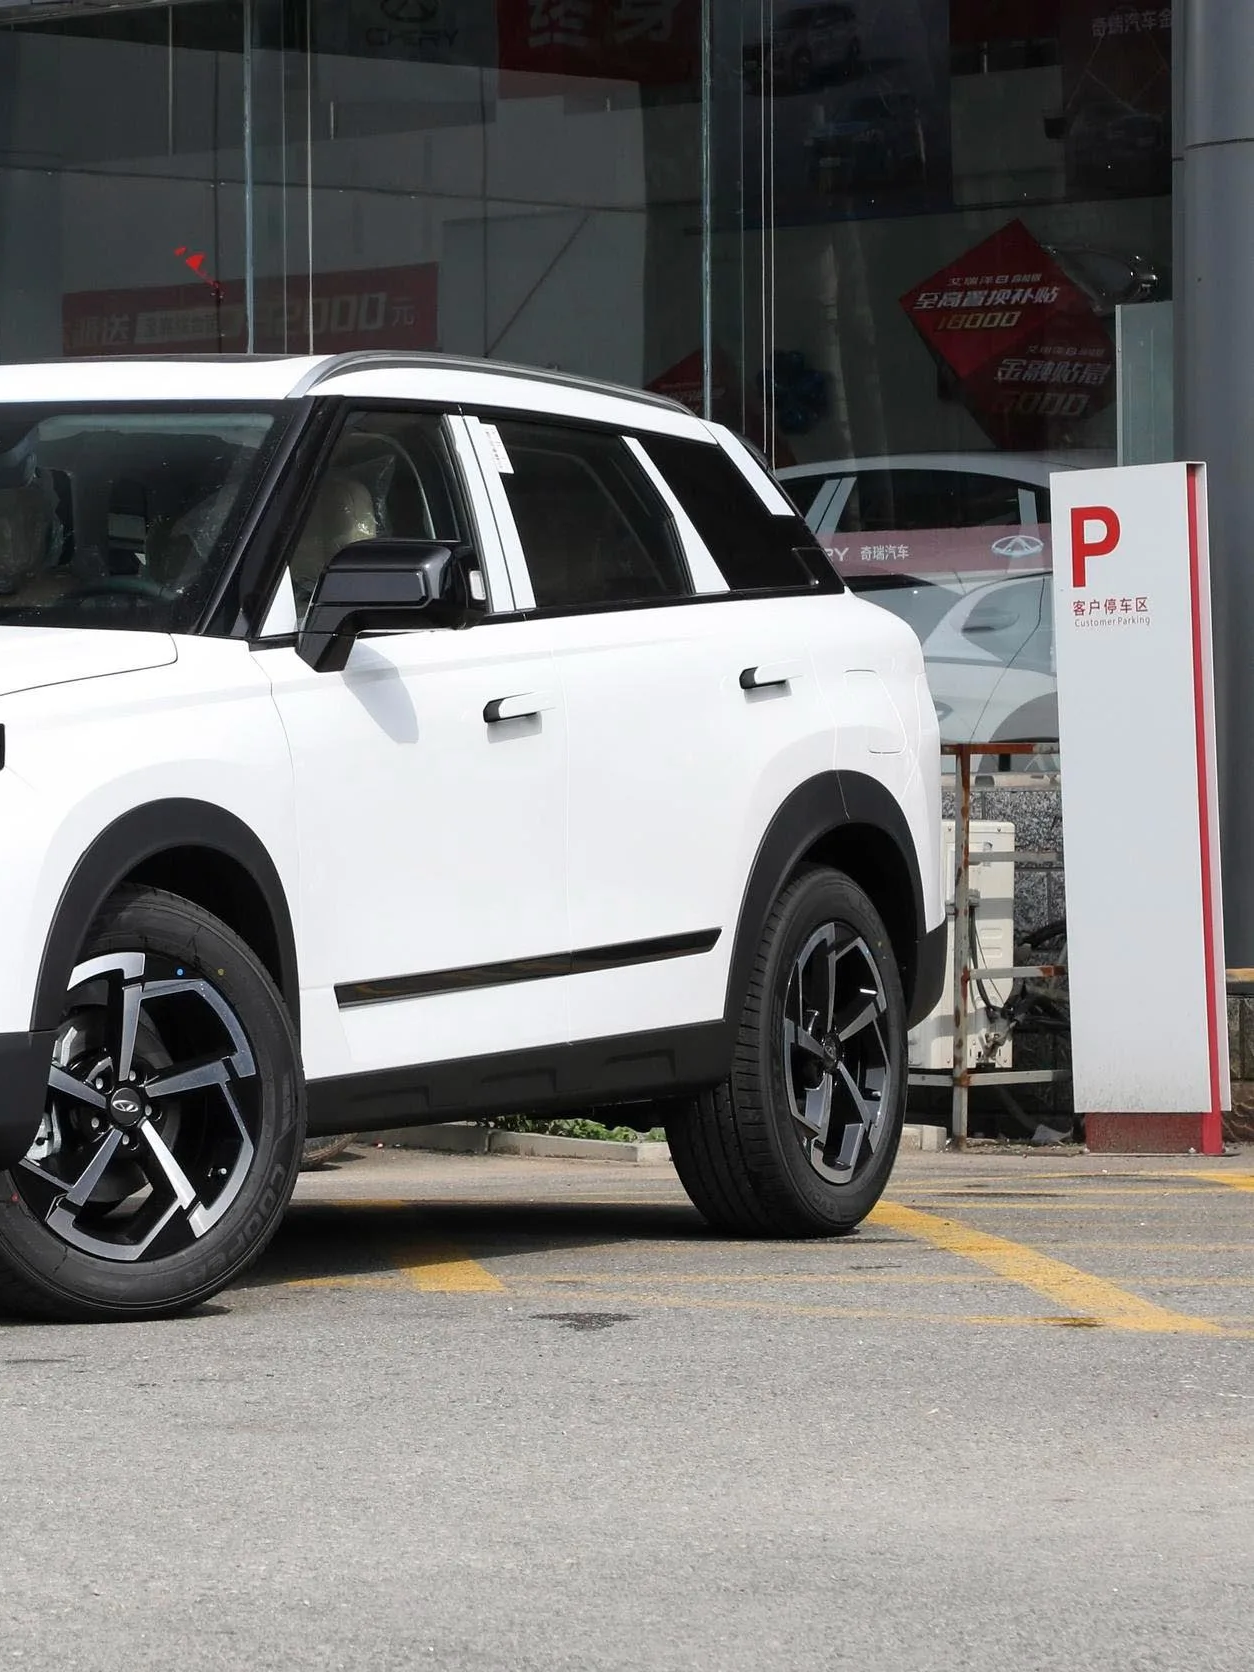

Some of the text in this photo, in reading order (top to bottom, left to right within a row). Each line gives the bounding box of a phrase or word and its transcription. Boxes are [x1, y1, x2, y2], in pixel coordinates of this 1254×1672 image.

[365, 27, 458, 48] CHERY
[860, 544, 910, 561] 奇瑞汽车
[1071, 505, 1121, 588] P
[1072, 597, 1149, 616] 客户停车区
[1074, 616, 1151, 627] Customer Parking
